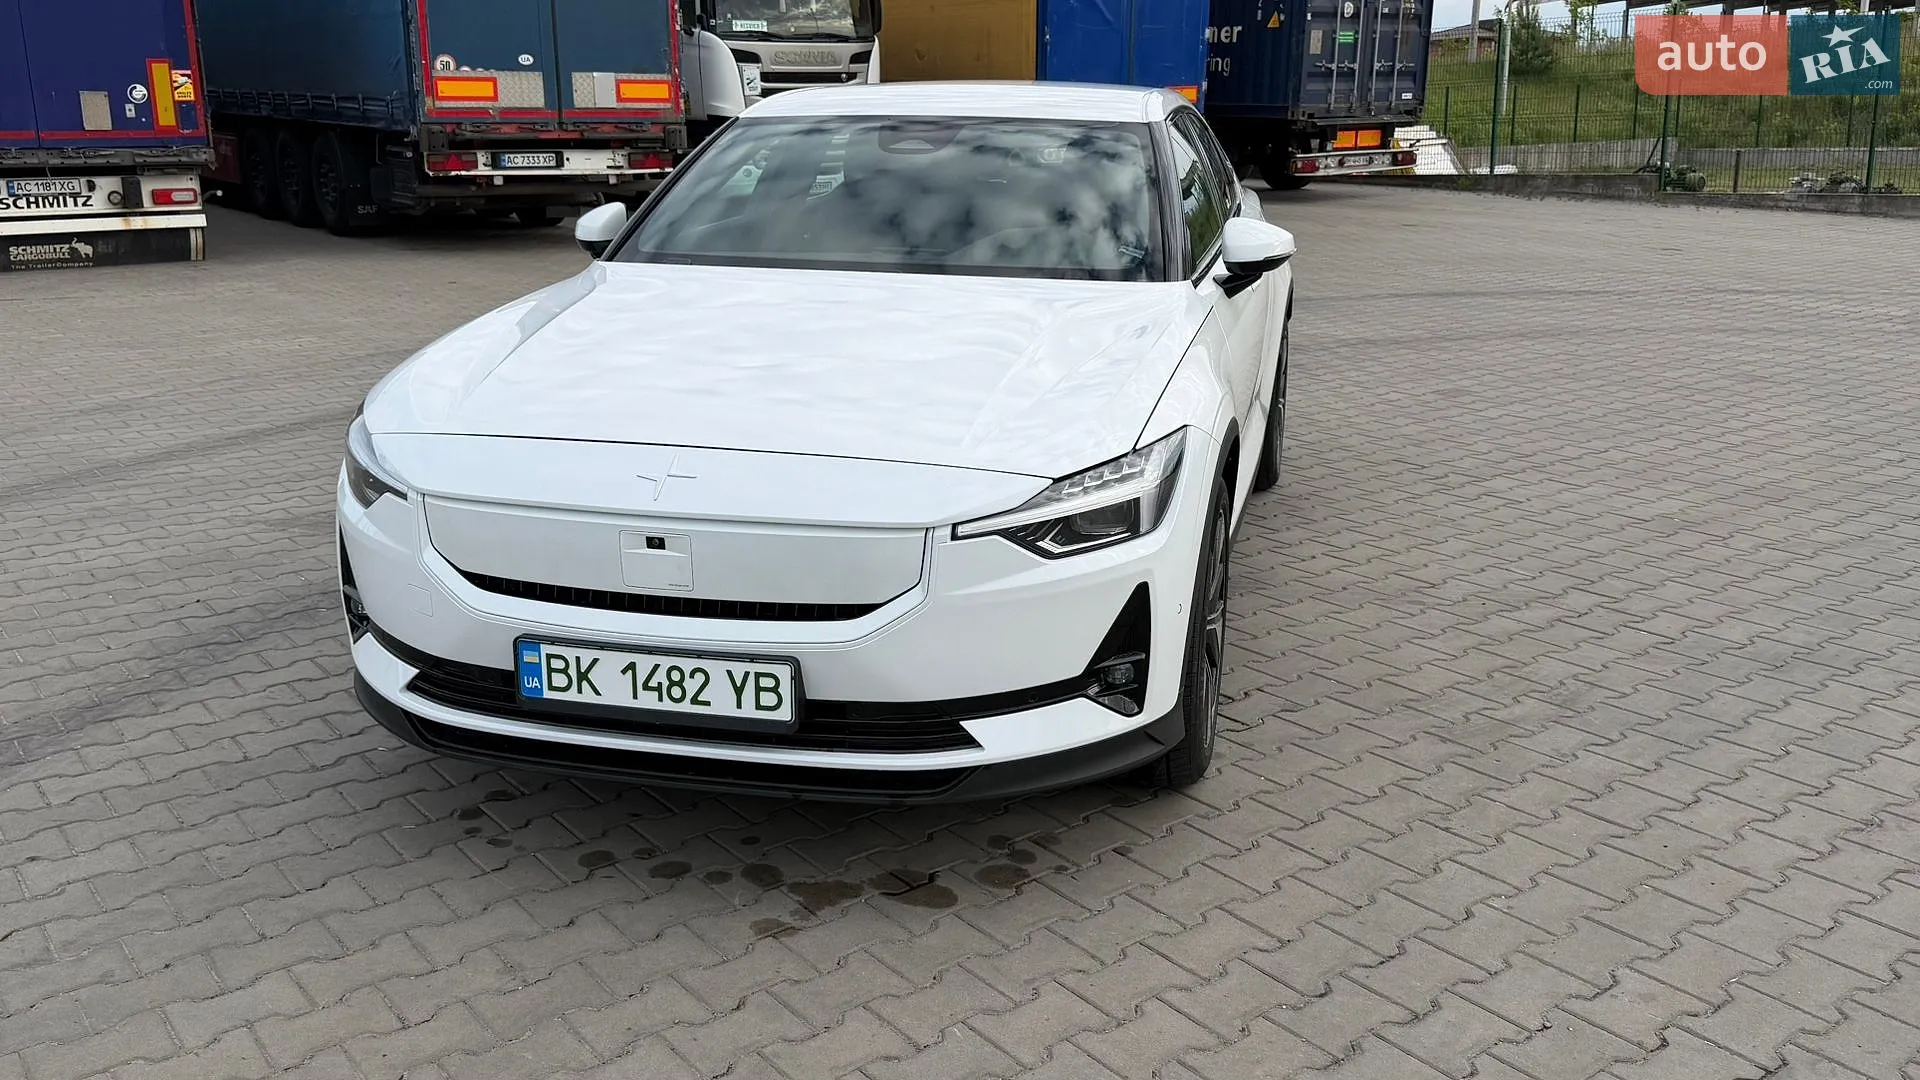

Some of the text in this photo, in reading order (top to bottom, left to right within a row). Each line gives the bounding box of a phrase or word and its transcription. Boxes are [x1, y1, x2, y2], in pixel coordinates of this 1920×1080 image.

[440, 60, 451, 71] 50
[507, 155, 555, 165] AC 7333 XP
[16, 181, 75, 193] AC 1181 XG
[0, 195, 94, 210] SCHMITZ
[9, 244, 70, 255] SCHMITZ
[10, 252, 71, 262] CARGOBULL
[524, 675, 541, 689] UA
[545, 652, 784, 712] BK 1482 YB
